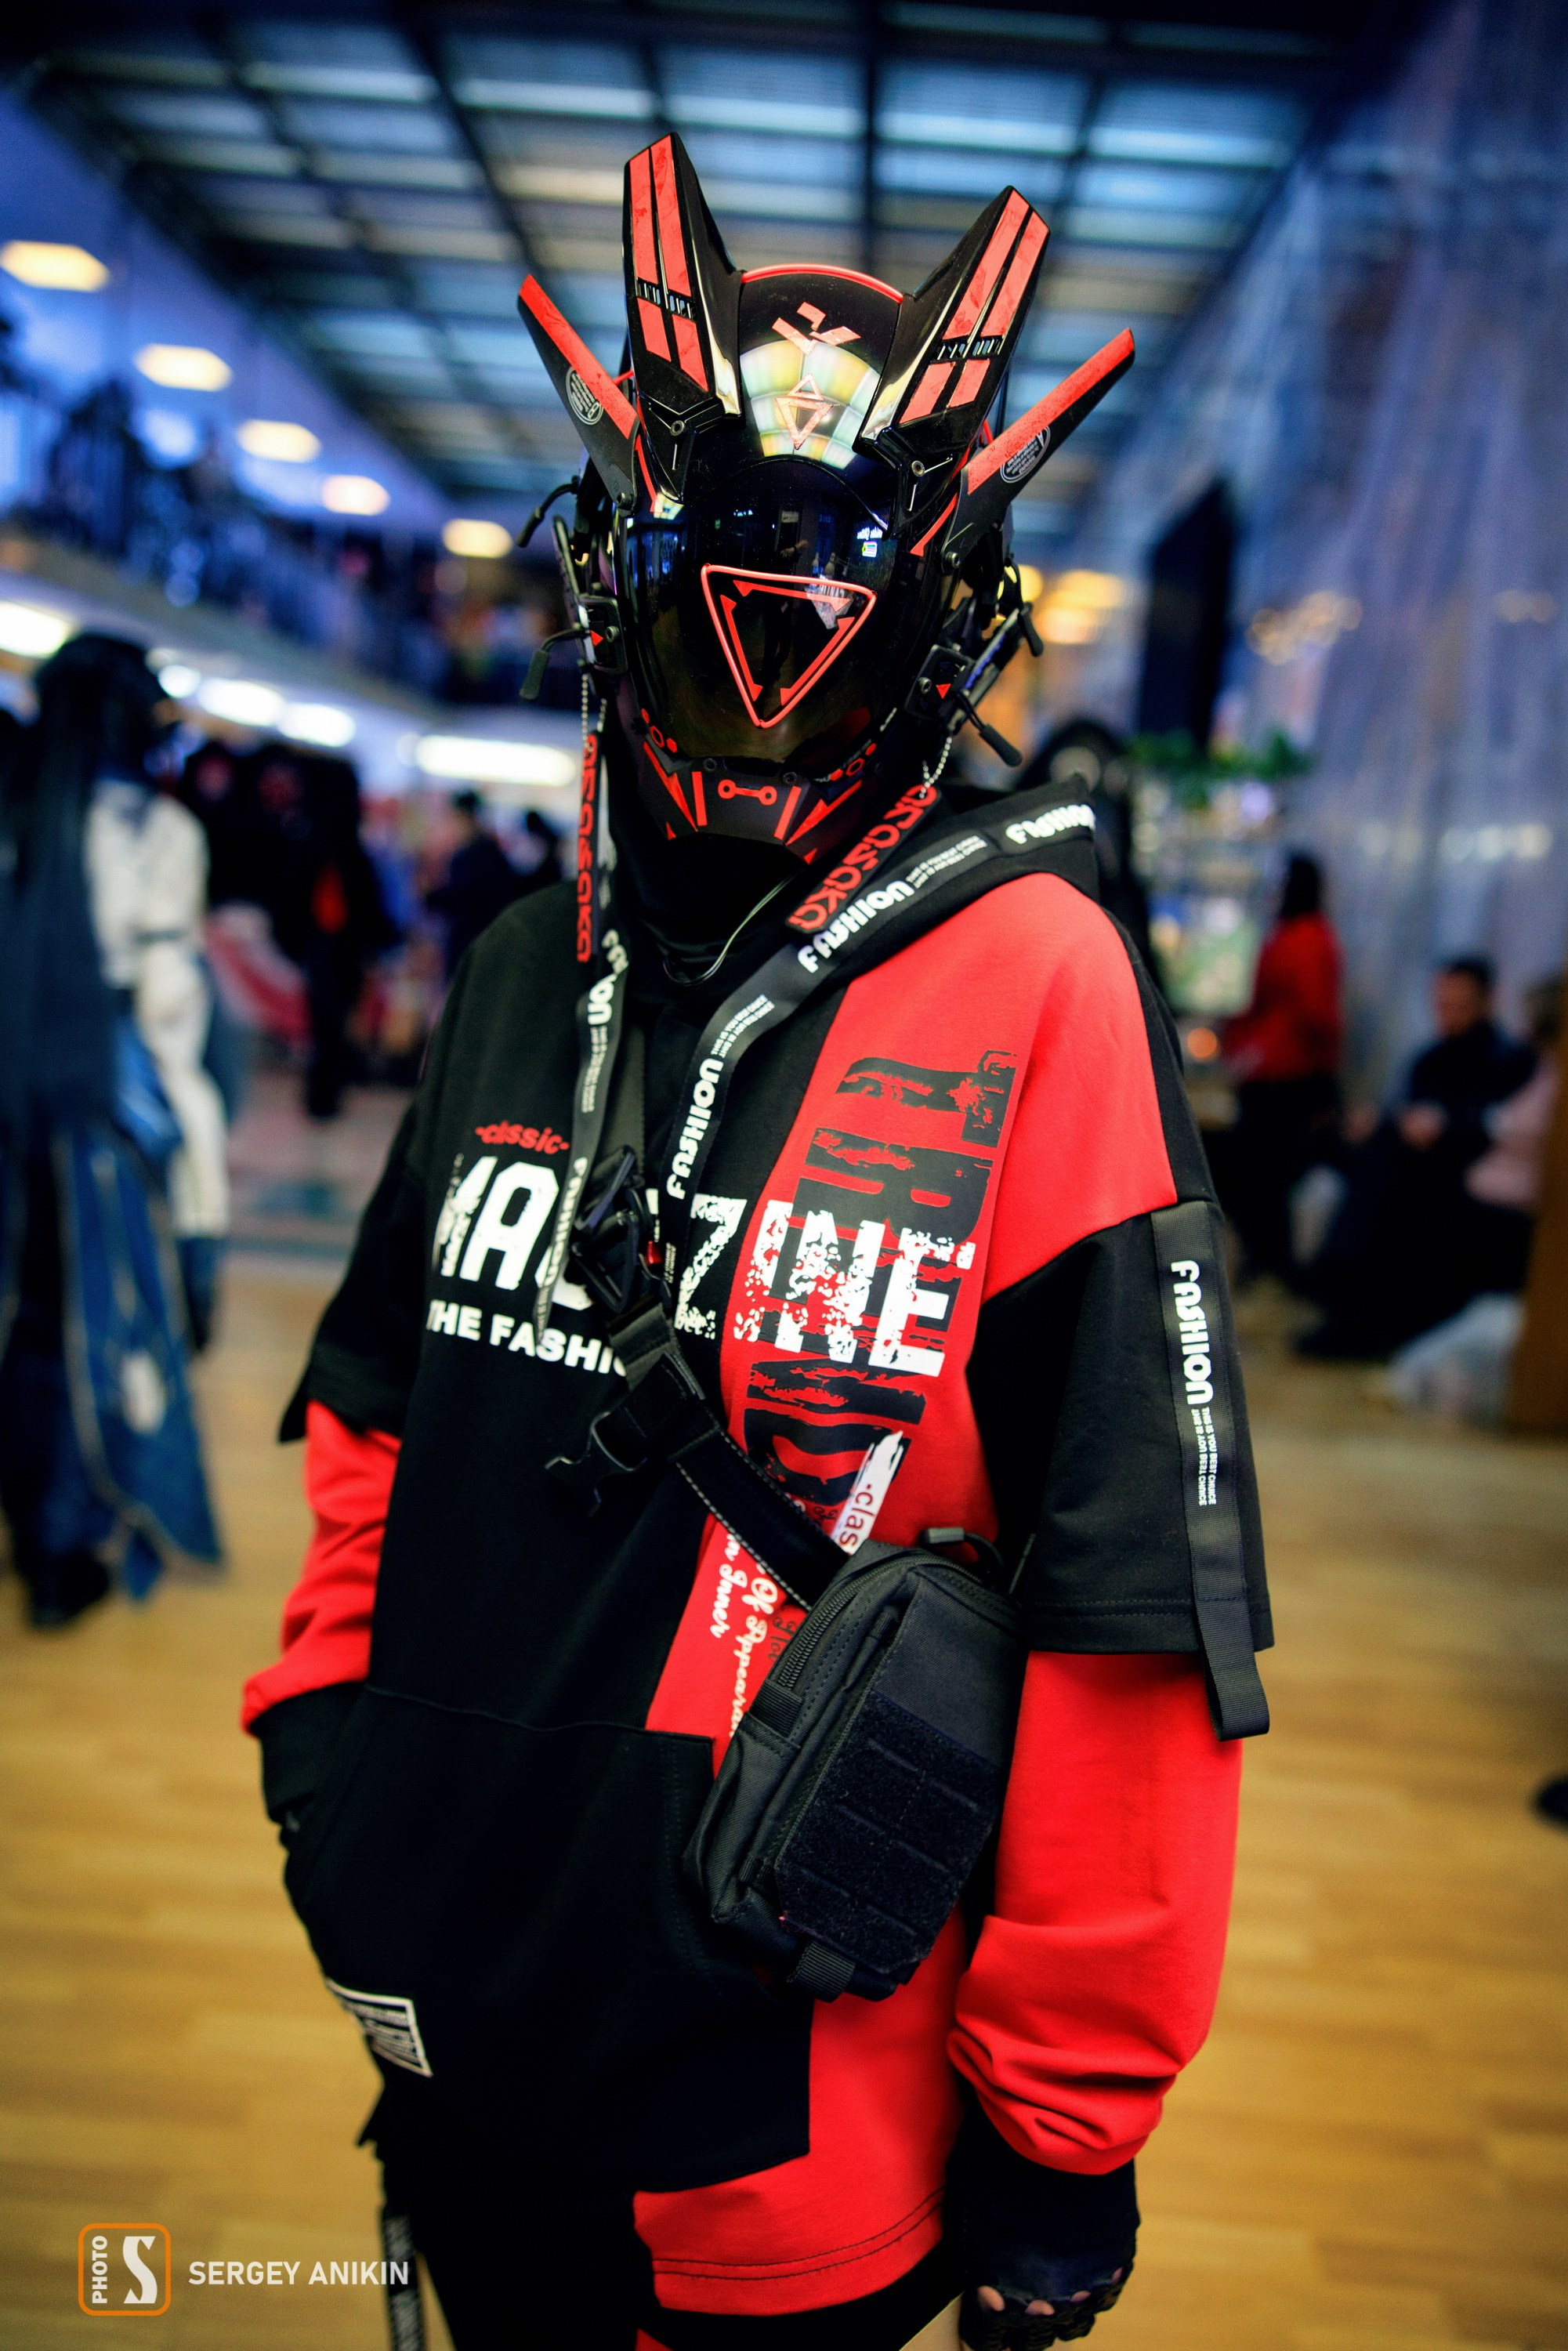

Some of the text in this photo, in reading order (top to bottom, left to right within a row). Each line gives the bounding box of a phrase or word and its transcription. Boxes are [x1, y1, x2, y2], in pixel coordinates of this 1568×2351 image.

[797, 880, 914, 974] FASHION
[666, 1057, 724, 1201] FASHION
[1170, 1259, 1214, 1405] FASHION
[1208, 1433, 1218, 1452] YOU
[709, 1563, 748, 1639] Inner
[741, 1578, 778, 1614] Of
